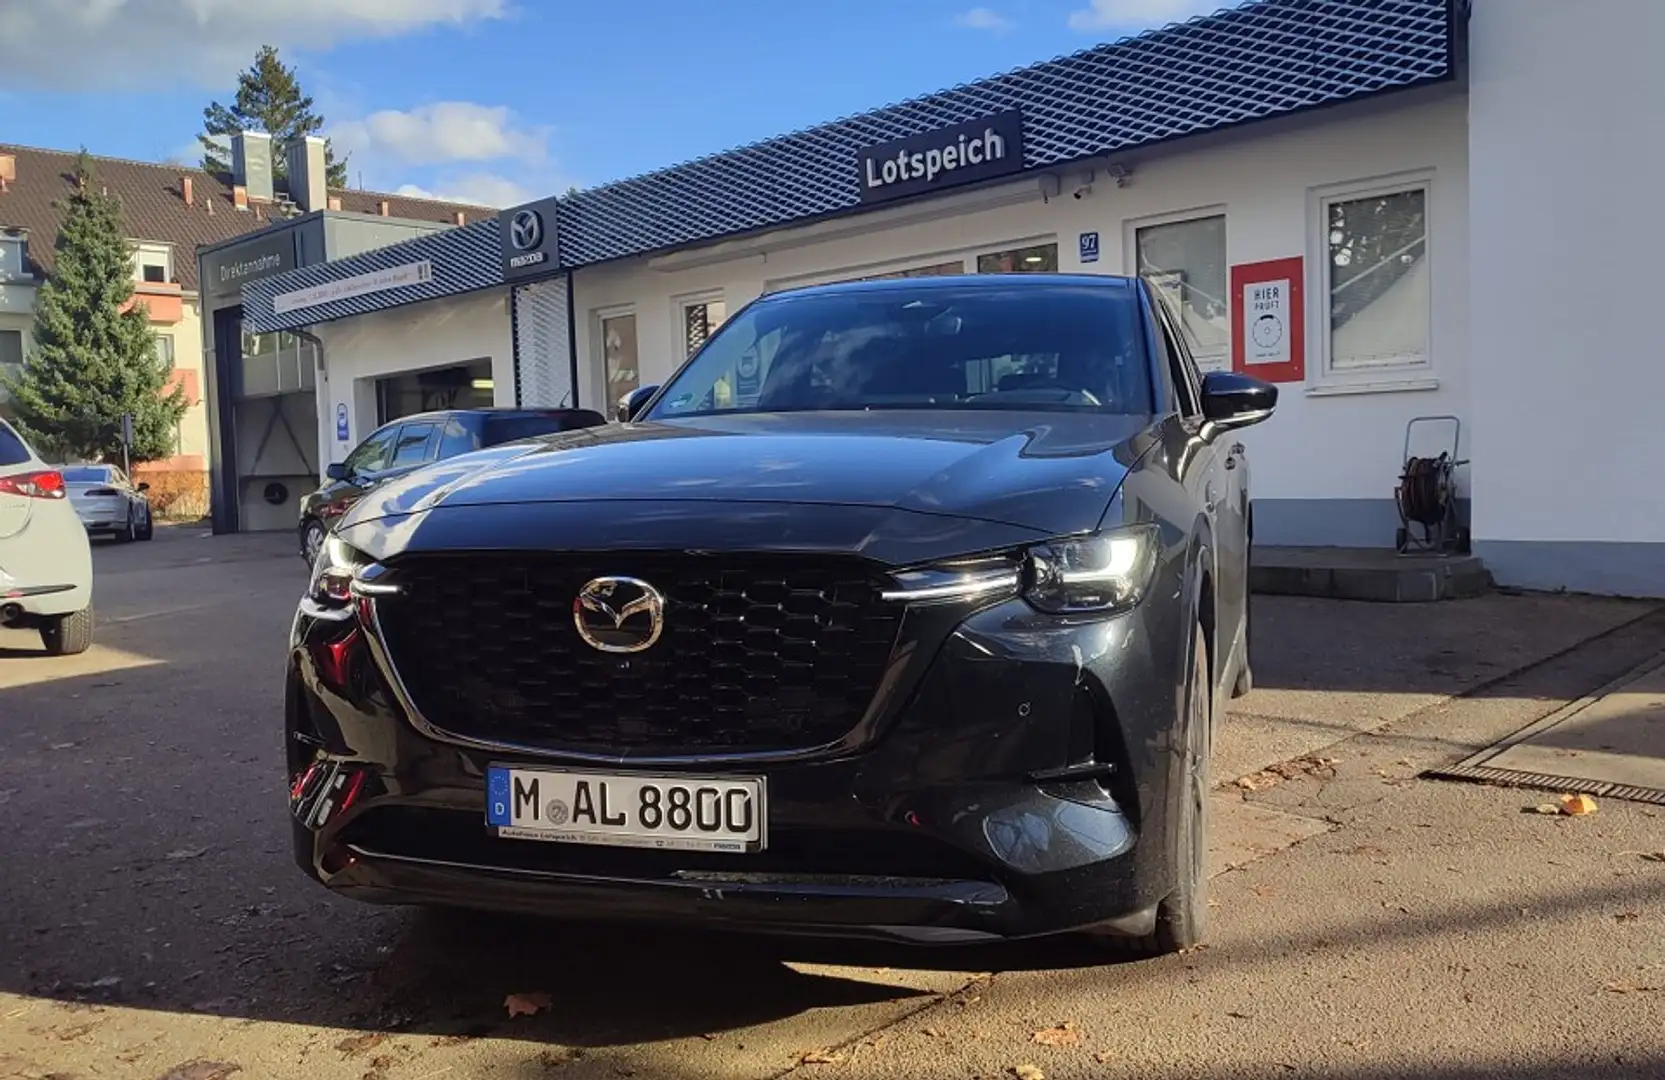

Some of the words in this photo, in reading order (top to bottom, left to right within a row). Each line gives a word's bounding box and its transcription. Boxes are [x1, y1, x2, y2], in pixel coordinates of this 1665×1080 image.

[866, 127, 1006, 188] Lotspeich
[1081, 234, 1097, 250] 97
[220, 253, 281, 281] Direktannahme
[1254, 286, 1280, 301] HIER
[513, 776, 540, 821] M
[572, 780, 627, 826] AL
[638, 784, 752, 833] 8800
